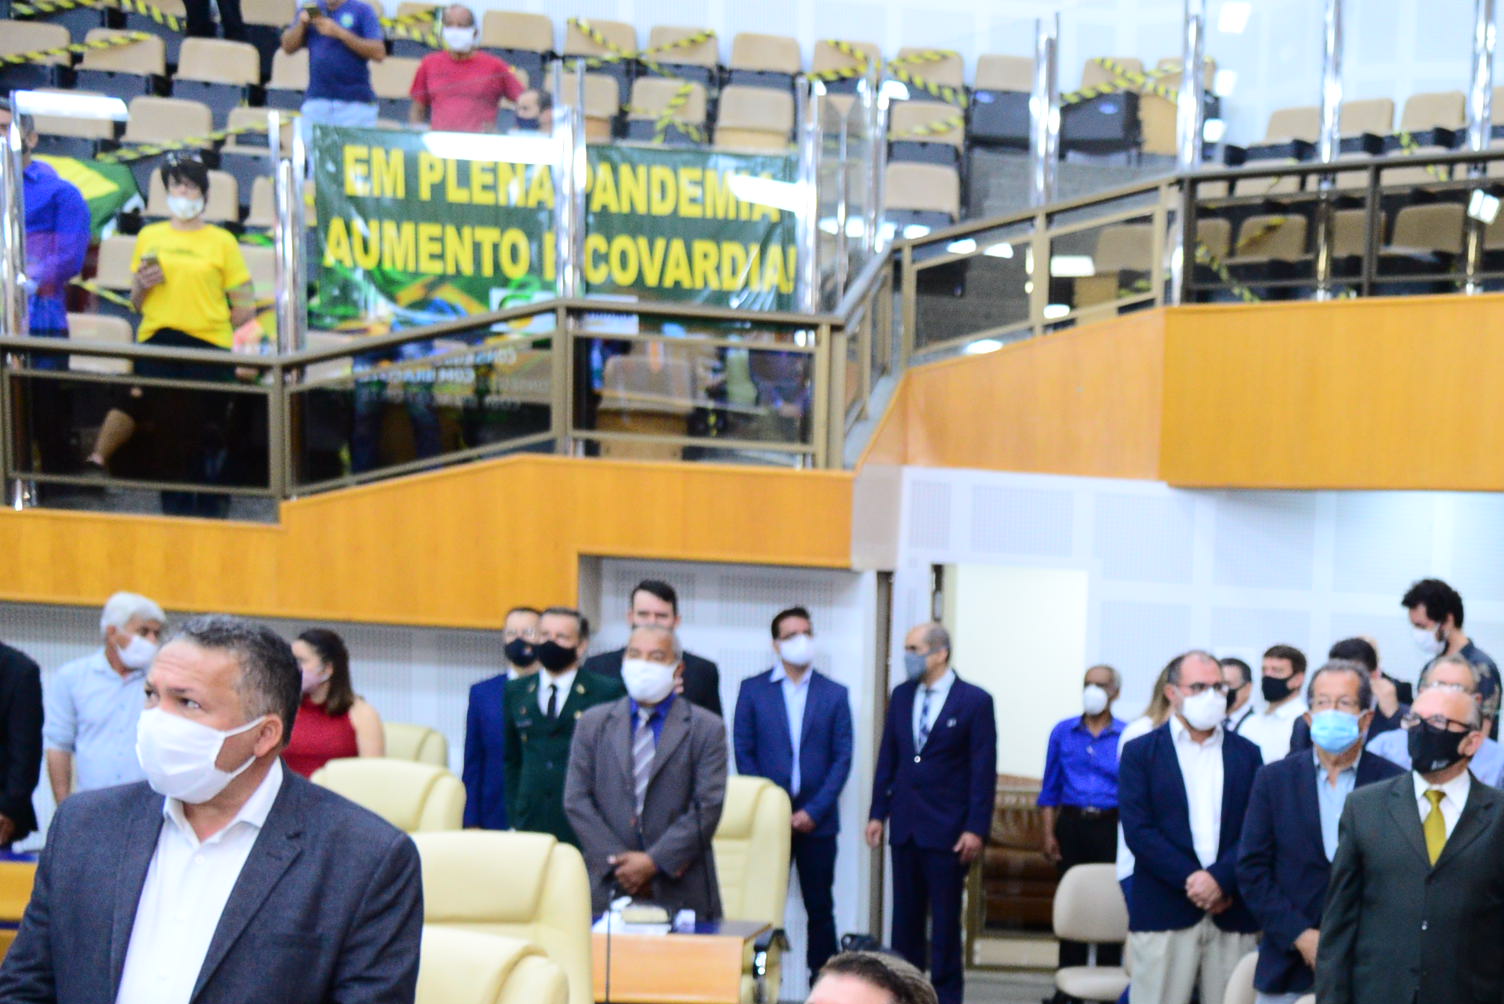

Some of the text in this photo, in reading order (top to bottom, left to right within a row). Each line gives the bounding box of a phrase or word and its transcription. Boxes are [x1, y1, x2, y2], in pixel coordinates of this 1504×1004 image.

[343, 144, 406, 199] EM
[418, 150, 556, 209] PLENA
[323, 216, 532, 280] AUMENTO
[584, 233, 797, 294] COVARDIA!
